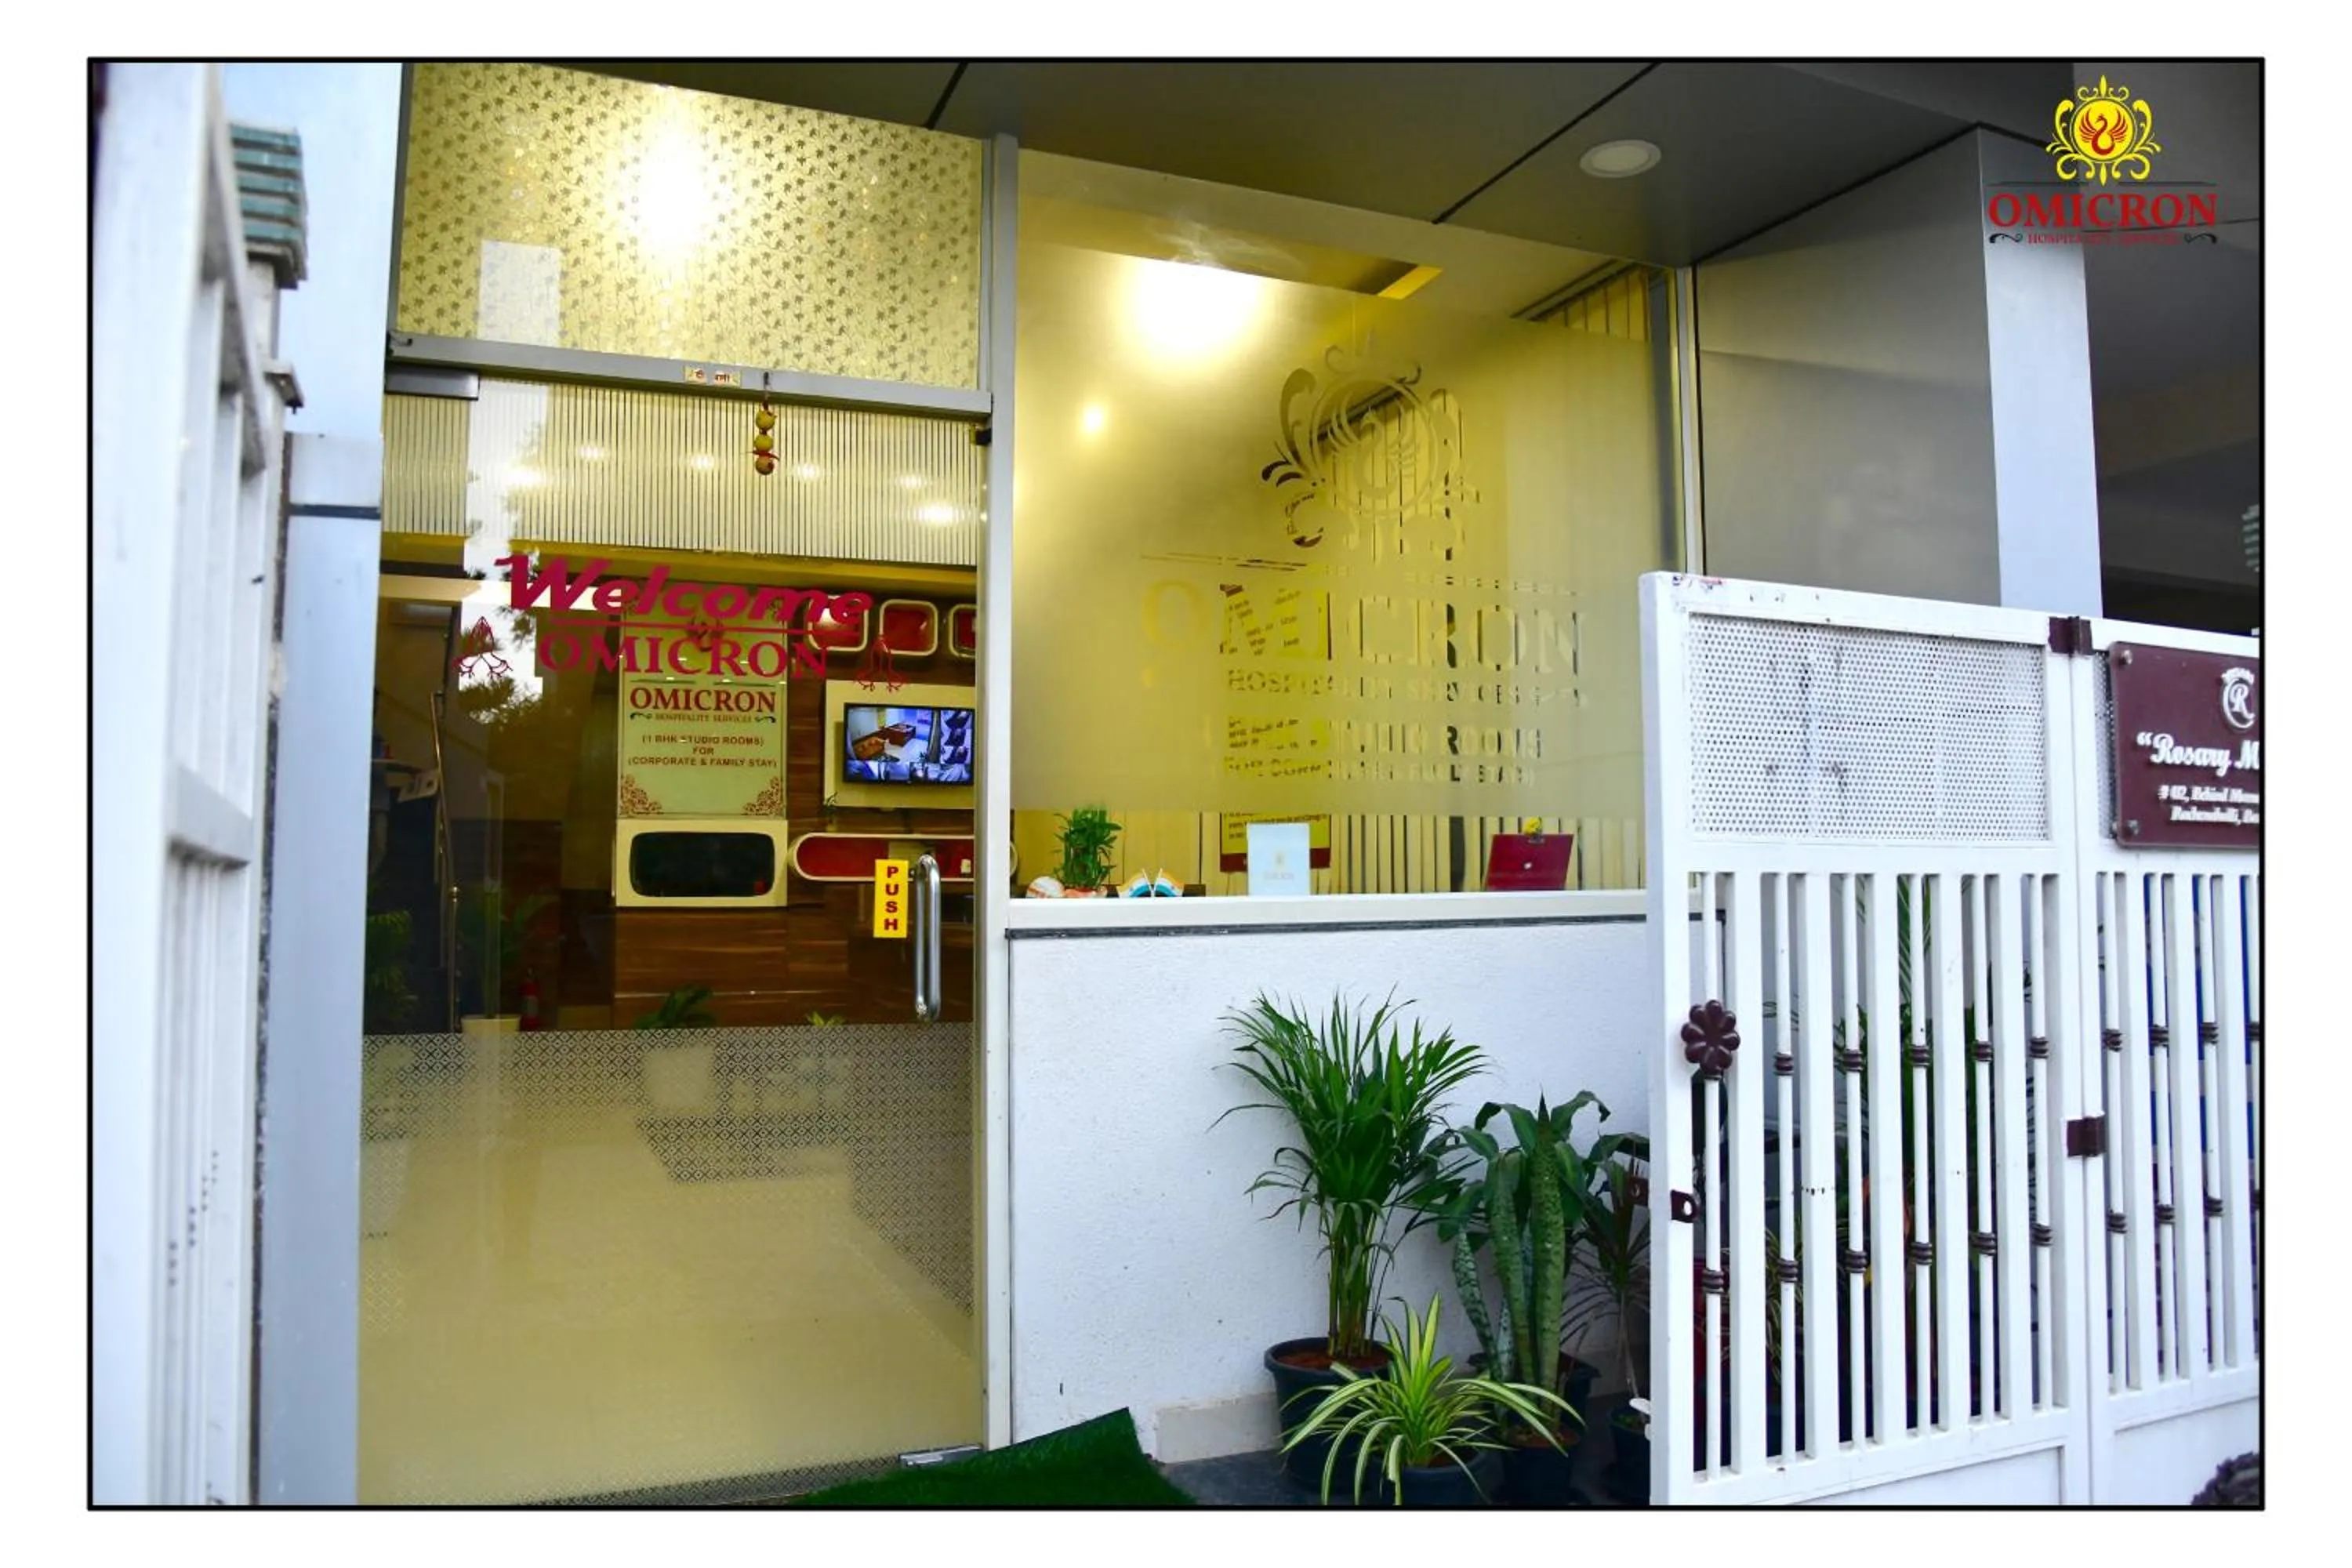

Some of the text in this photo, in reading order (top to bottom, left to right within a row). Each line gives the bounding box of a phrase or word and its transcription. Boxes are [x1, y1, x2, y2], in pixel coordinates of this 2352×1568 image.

[494, 554, 873, 625] Welcome
[539, 632, 829, 680] OMICRON
[630, 687, 776, 713] OMICRON
[655, 735, 677, 744] BHK
[681, 735, 720, 746] STUDIO
[722, 736, 764, 747] ROOMS)
[692, 747, 714, 756] FOR
[628, 756, 777, 768] (CORPORATE & FAMILY STAY)
[884, 866, 899, 931] PUSH
